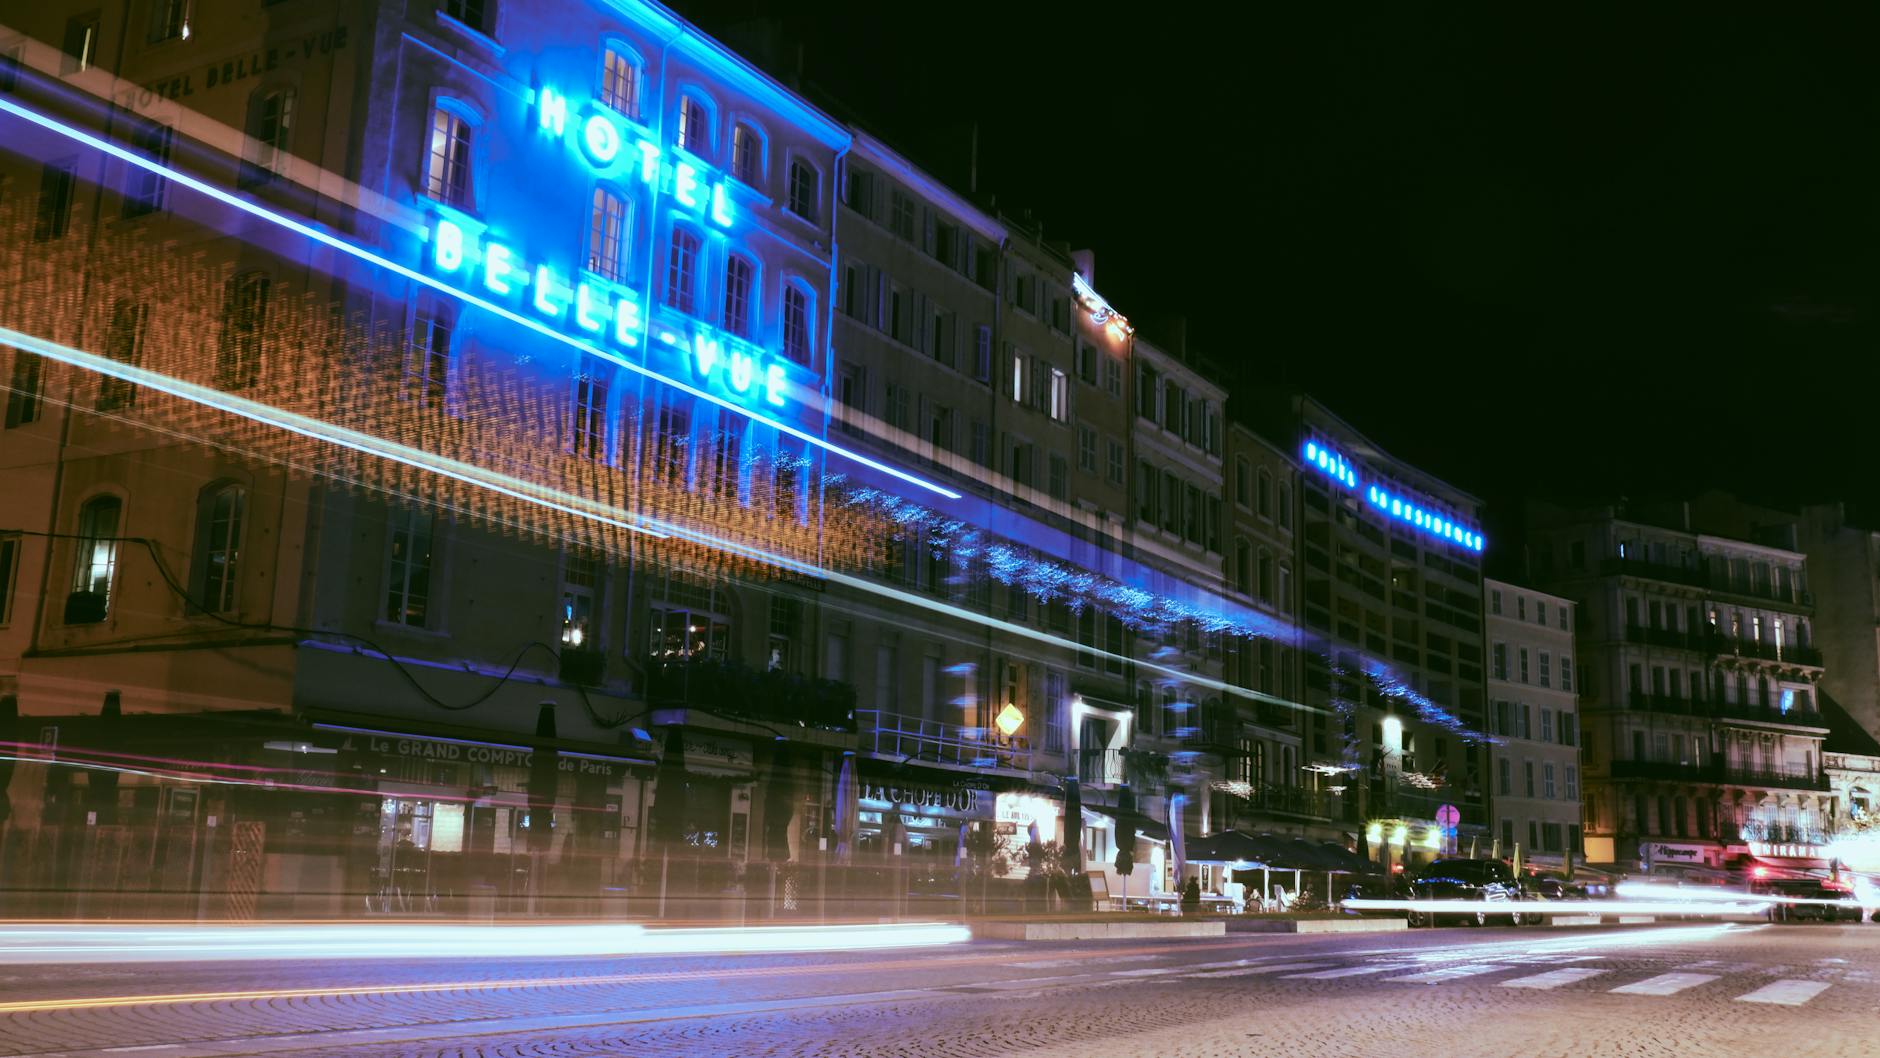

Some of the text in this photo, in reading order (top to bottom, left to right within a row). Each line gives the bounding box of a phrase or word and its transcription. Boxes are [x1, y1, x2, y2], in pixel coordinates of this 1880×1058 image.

[205, 26, 348, 89] BELLE-VUE
[539, 87, 733, 228] HOTEL
[435, 218, 787, 407] BELLE-VUE
[1306, 442, 1482, 551] HOTEL LA RESIDENCE
[371, 736, 389, 753] Le
[399, 739, 460, 760] GRAND
[558, 758, 575, 772] de
[579, 760, 613, 776] Paris
[865, 783, 887, 801] LA
[890, 786, 942, 807] CHOPE
